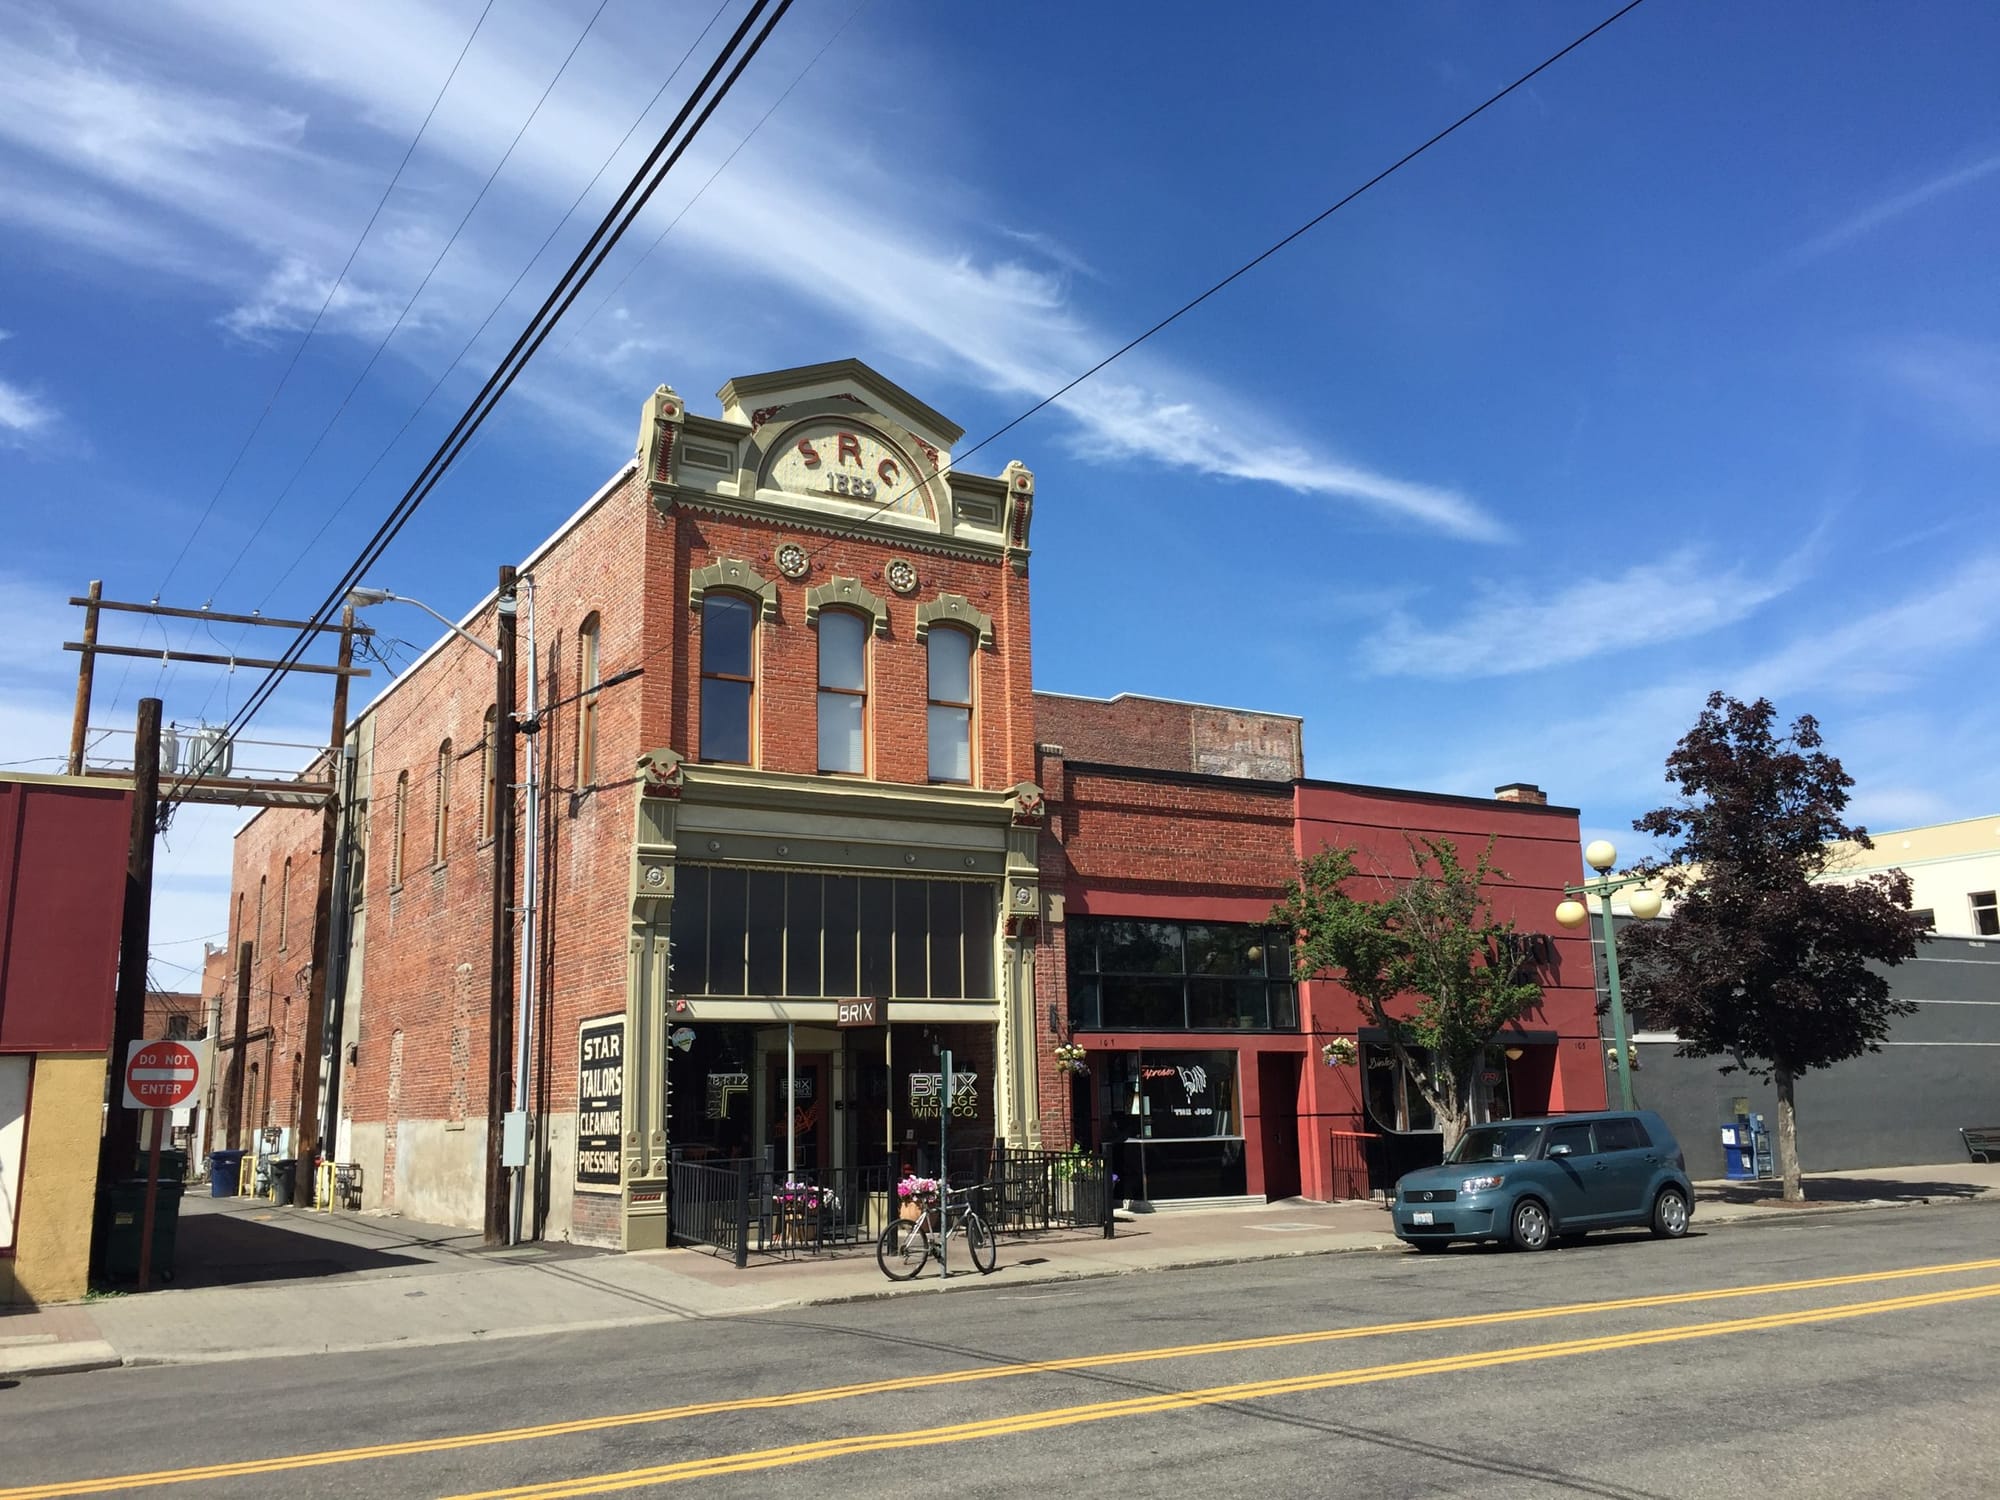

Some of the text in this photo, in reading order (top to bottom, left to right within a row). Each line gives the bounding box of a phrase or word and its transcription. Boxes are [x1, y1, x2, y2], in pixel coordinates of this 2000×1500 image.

[826, 471, 875, 497] 1889
[839, 1002, 873, 1022] BRIX
[584, 1034, 620, 1061] STAR
[139, 1054, 190, 1065] DO NOT
[140, 1083, 182, 1095] ENTER
[582, 1066, 622, 1099] TAILORS
[712, 1075, 749, 1086] BRIX
[912, 1106, 978, 1119] WIN CO.
[1173, 1108, 1192, 1116] THE
[580, 1110, 620, 1137] CLEANING
[578, 1150, 620, 1174] PRESSING
